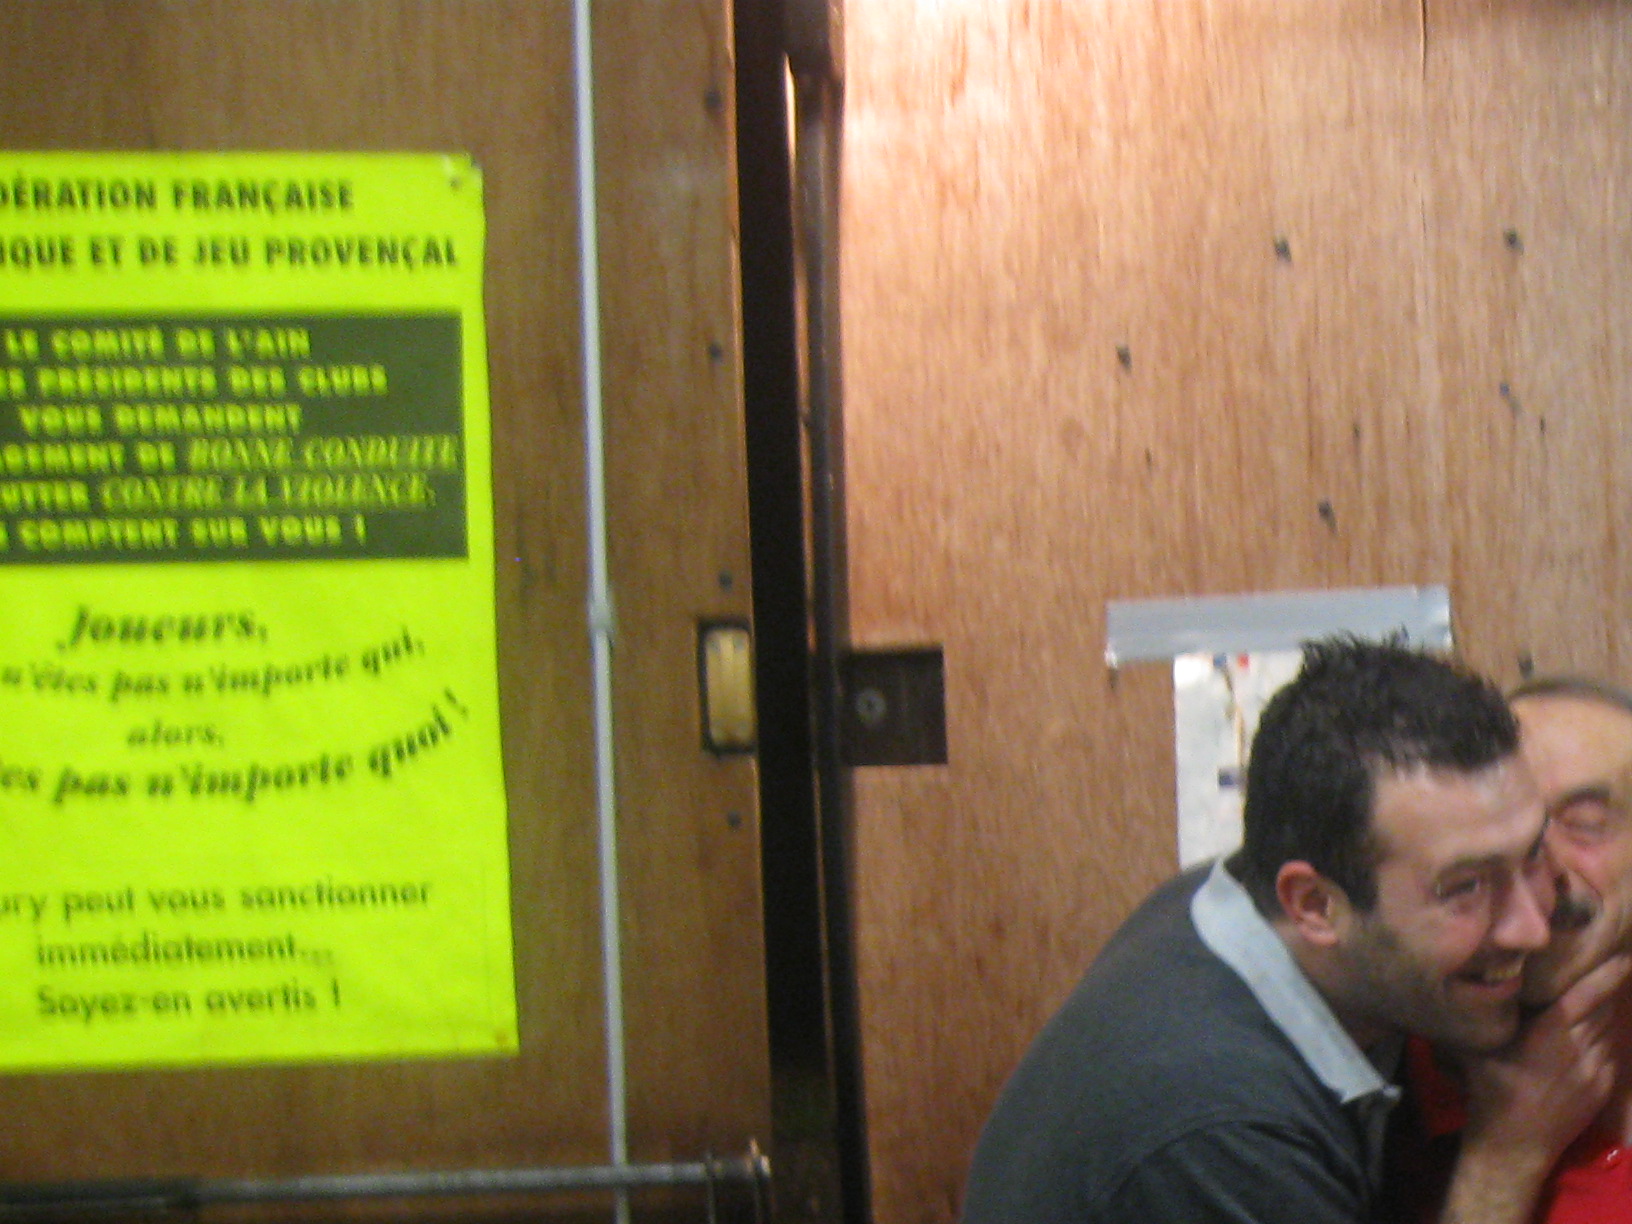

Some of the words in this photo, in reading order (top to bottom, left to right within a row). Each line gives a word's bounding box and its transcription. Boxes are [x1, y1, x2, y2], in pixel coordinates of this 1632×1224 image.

[173, 178, 353, 216] FRANÇAISE
[89, 235, 124, 267] ET
[137, 236, 177, 267] DE
[194, 236, 250, 267] JEU
[264, 235, 457, 272] PROVENÇAL
[5, 329, 39, 360] LE
[52, 325, 165, 360] COMITÉ
[176, 328, 216, 360] DE
[228, 365, 286, 398] DES
[299, 363, 389, 397] CLUBS
[19, 404, 103, 437] VOUS
[112, 403, 302, 435] DEMANDENT
[136, 440, 176, 472] DE
[18, 518, 179, 550] COMPTENT
[191, 516, 250, 548] SUR
[258, 515, 342, 547] VOUS
[55, 604, 268, 653] Joueurs,
[109, 671, 169, 704] pas
[183, 655, 349, 699] n'importe
[53, 766, 131, 807] pas
[148, 752, 353, 808] n'importe
[62, 885, 136, 926] peut
[148, 887, 224, 914] vous
[240, 874, 432, 909] sanctionner
[205, 975, 318, 1015] avertis
